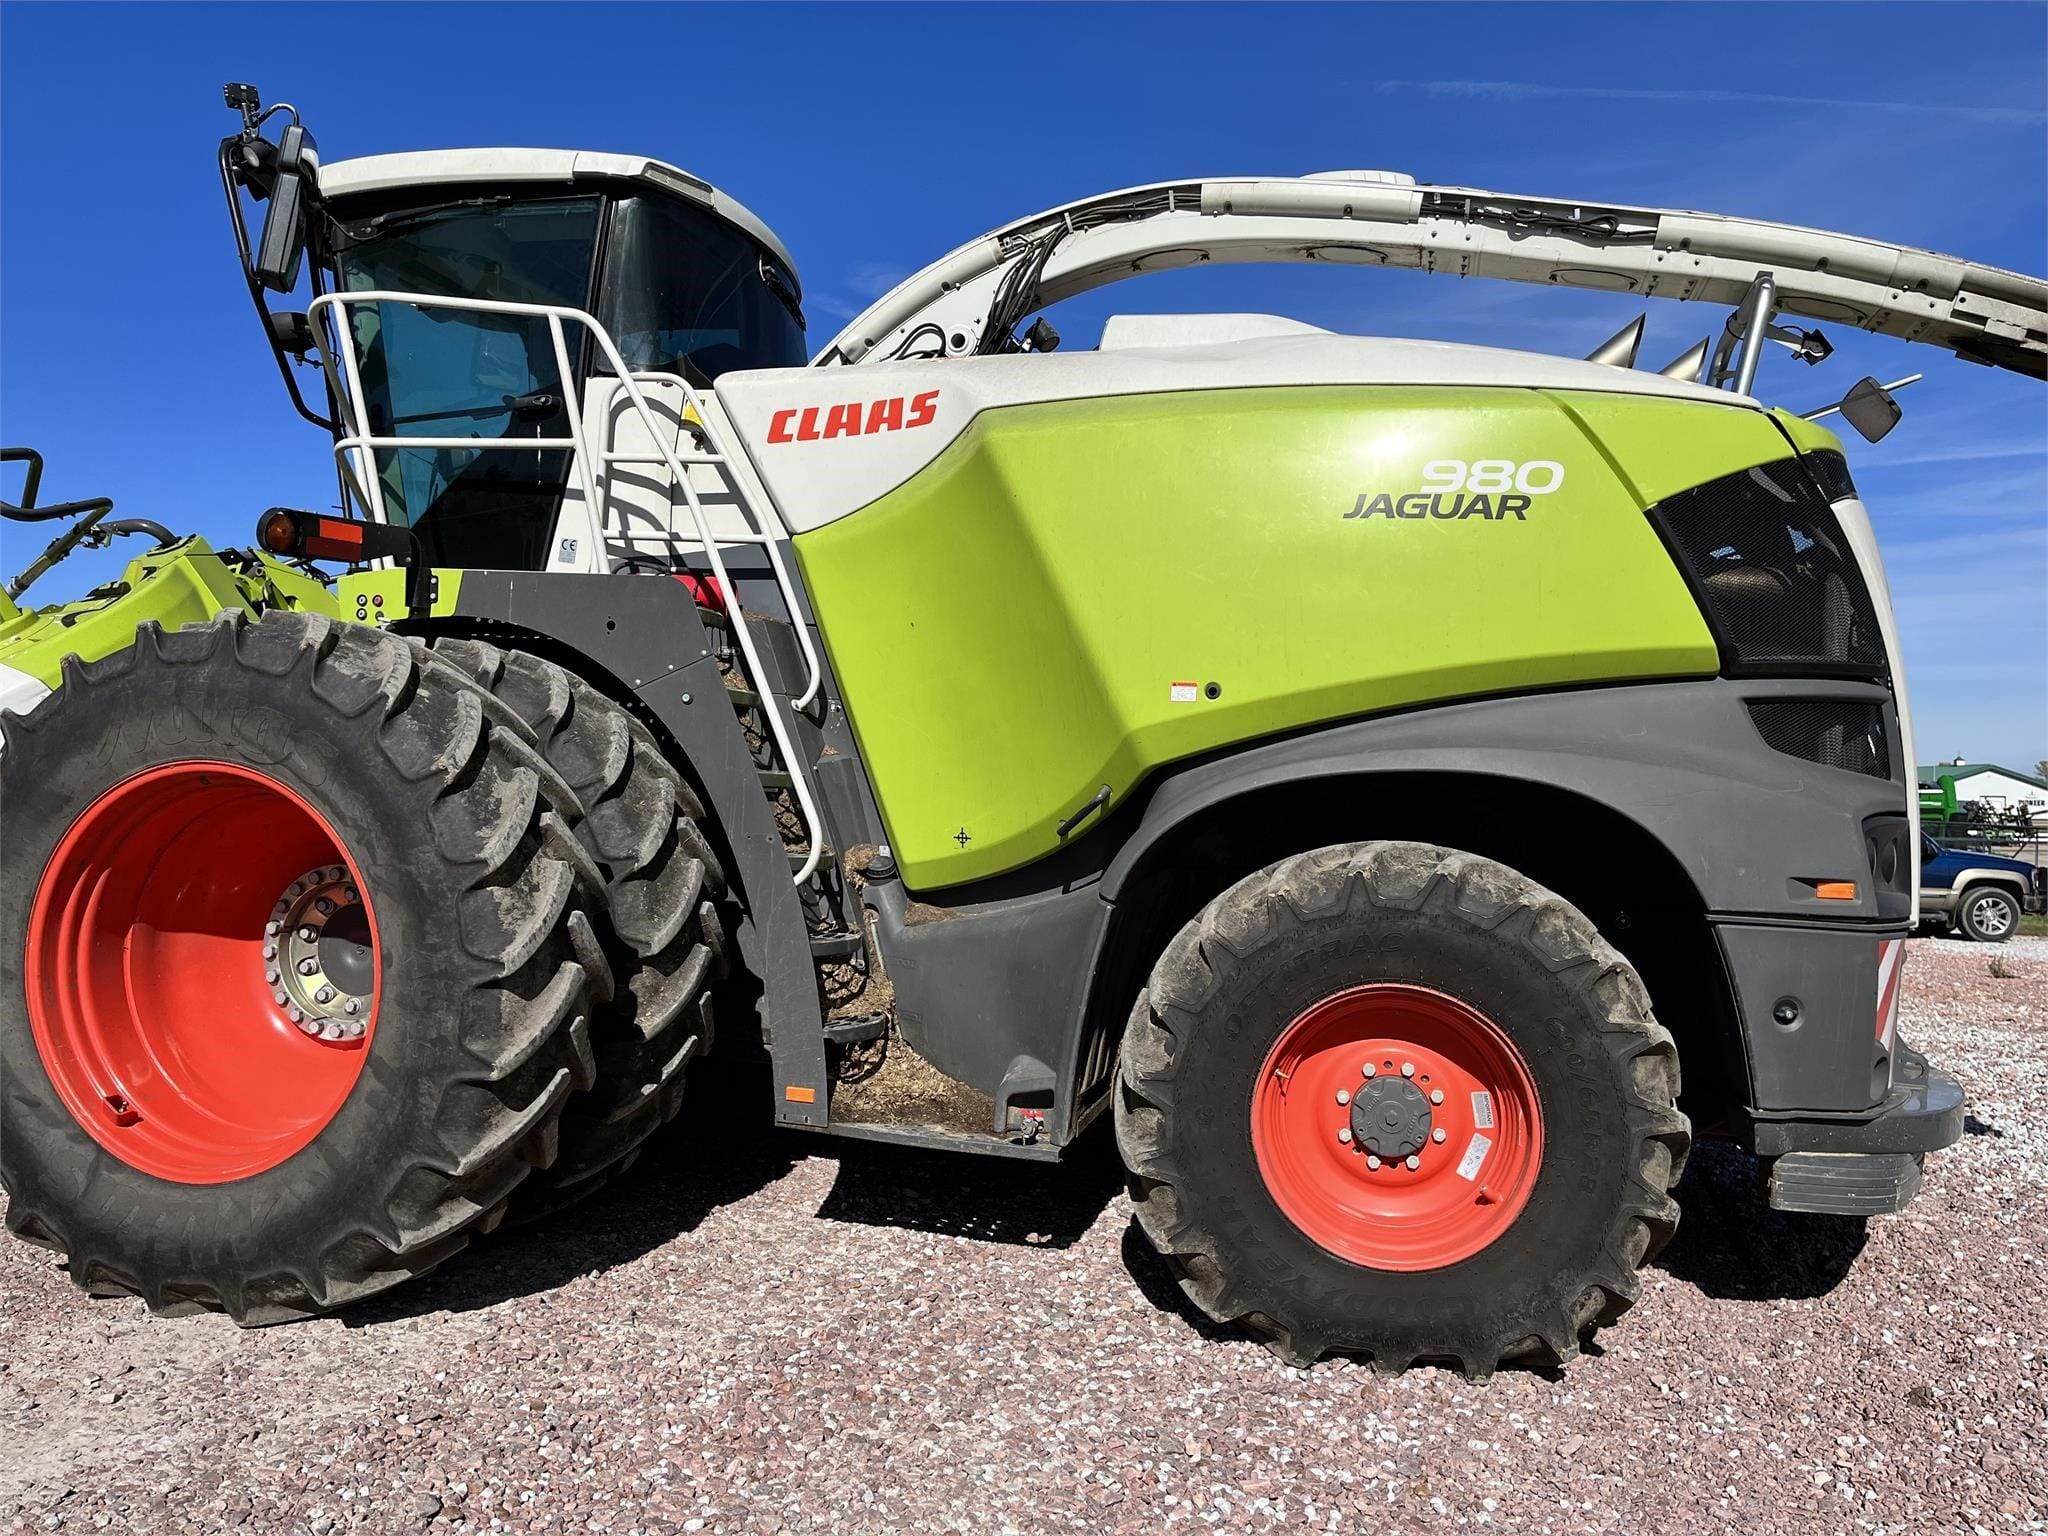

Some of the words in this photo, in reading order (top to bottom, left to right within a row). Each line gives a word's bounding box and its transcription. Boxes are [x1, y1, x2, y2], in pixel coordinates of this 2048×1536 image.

[767, 389, 940, 444] CLAAS
[1420, 459, 1565, 495] 980
[1342, 493, 1532, 521] JAGUAR
